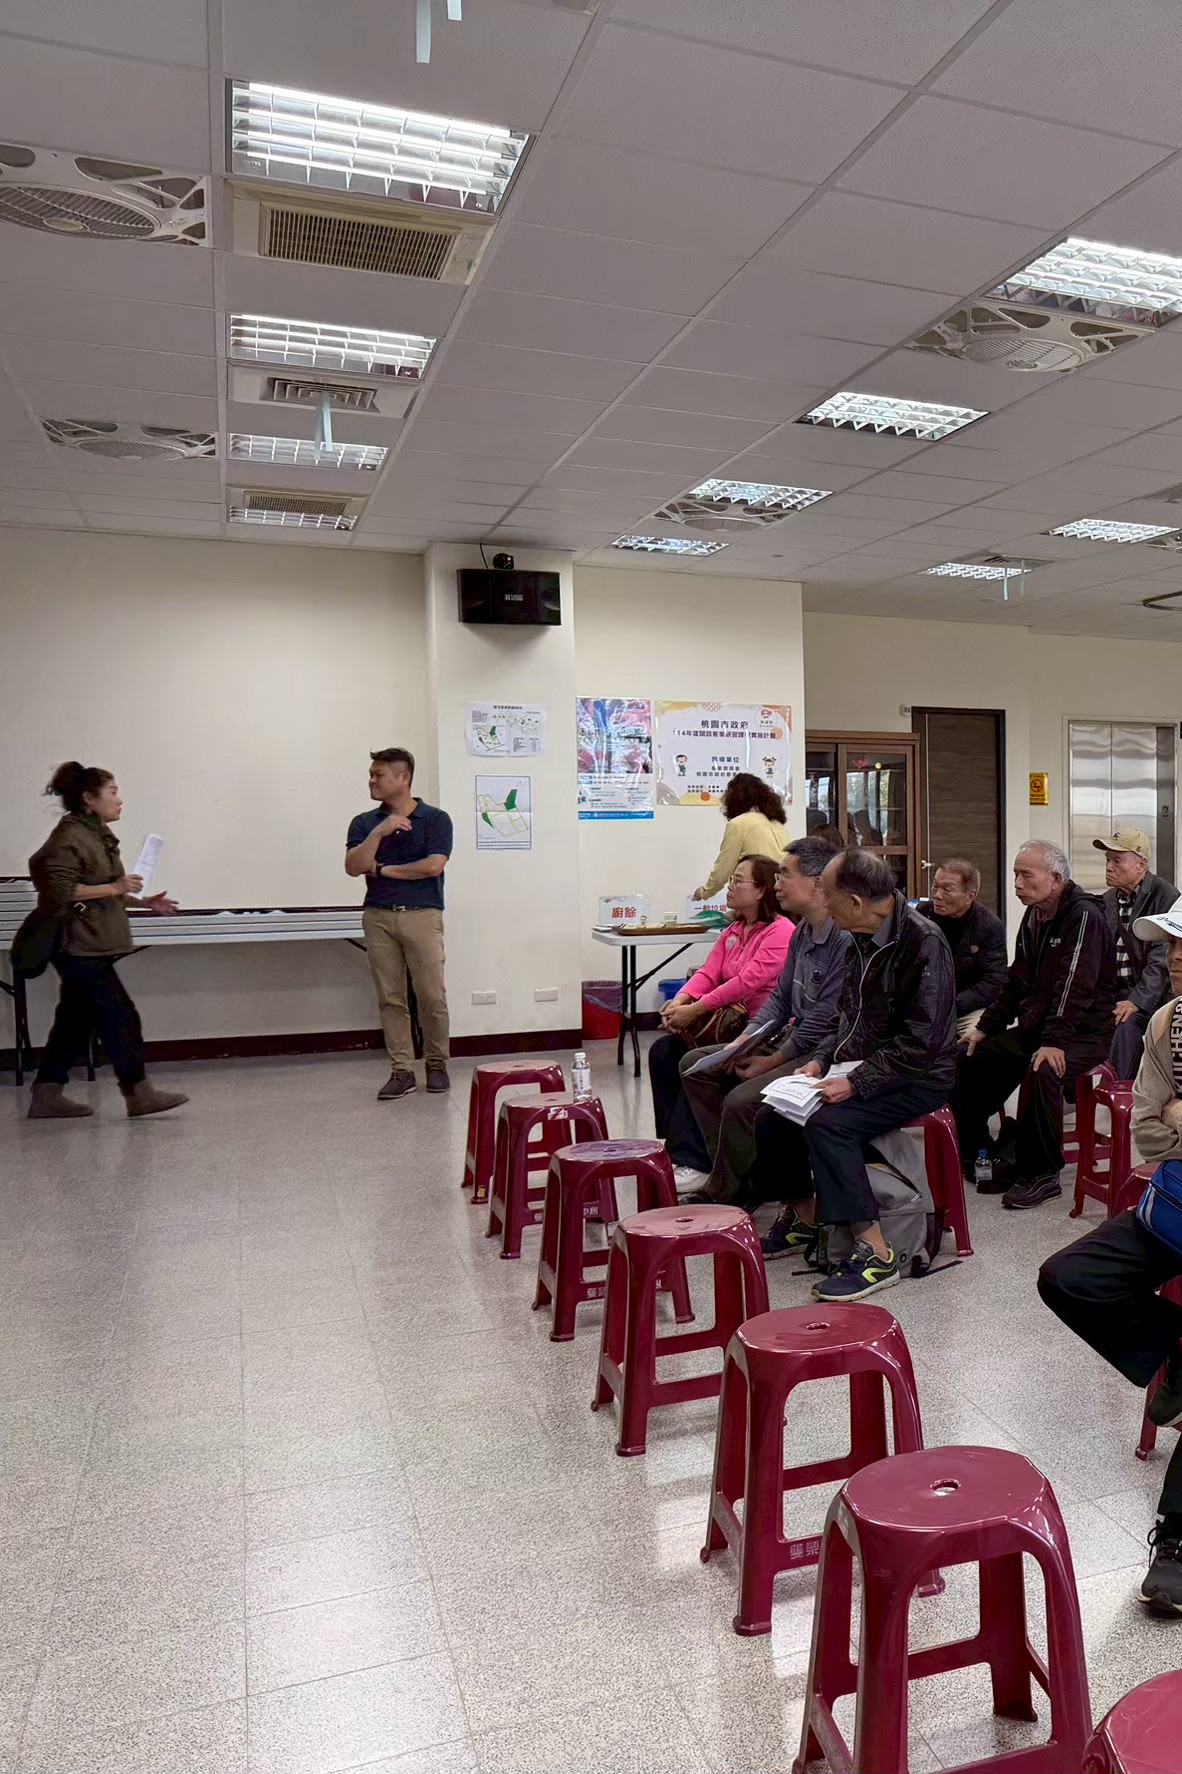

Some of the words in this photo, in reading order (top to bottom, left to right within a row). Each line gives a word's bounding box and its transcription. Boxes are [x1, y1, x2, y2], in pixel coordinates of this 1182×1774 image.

[701, 719, 749, 729] 桃園市政府
[611, 906, 637, 918] 廚餘
